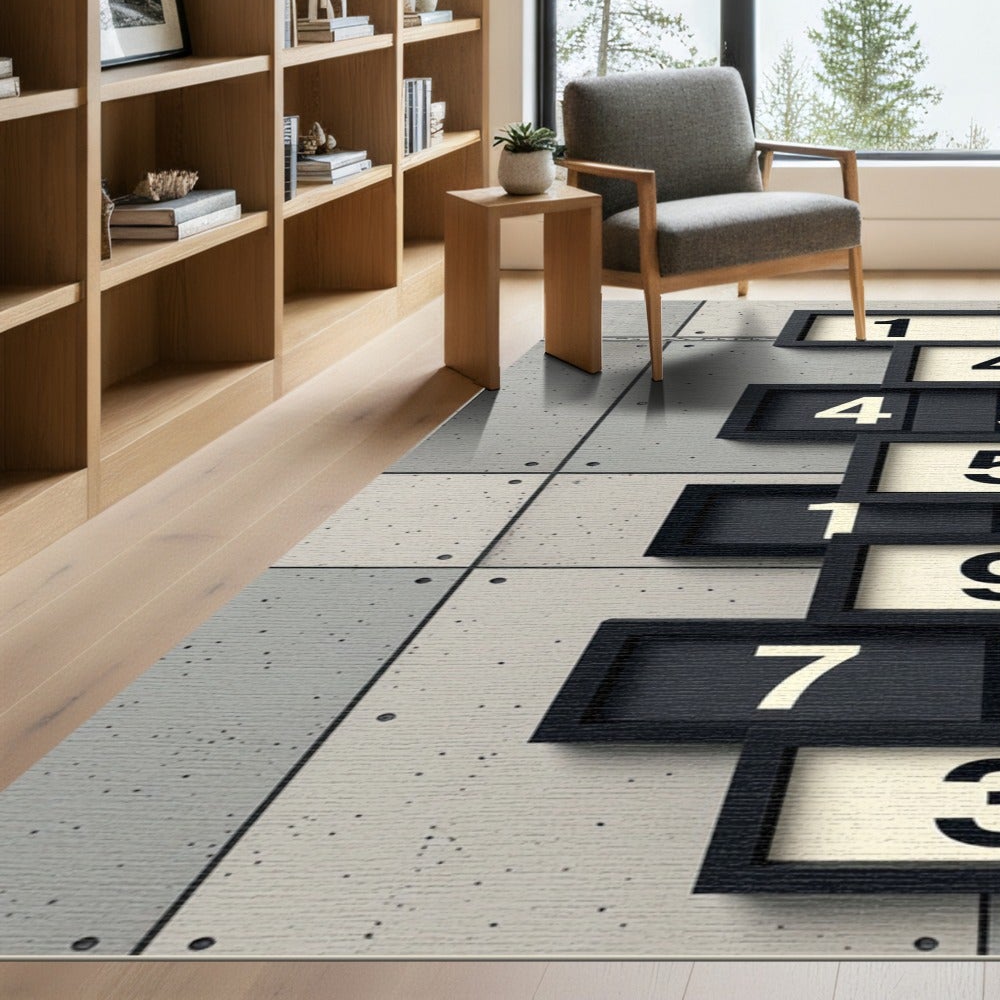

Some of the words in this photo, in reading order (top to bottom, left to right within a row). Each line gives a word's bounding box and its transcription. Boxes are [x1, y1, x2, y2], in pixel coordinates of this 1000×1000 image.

[875, 319, 910, 337] 1
[815, 397, 892, 424] 4
[808, 502, 859, 539] 1
[754, 645, 861, 709] 7
